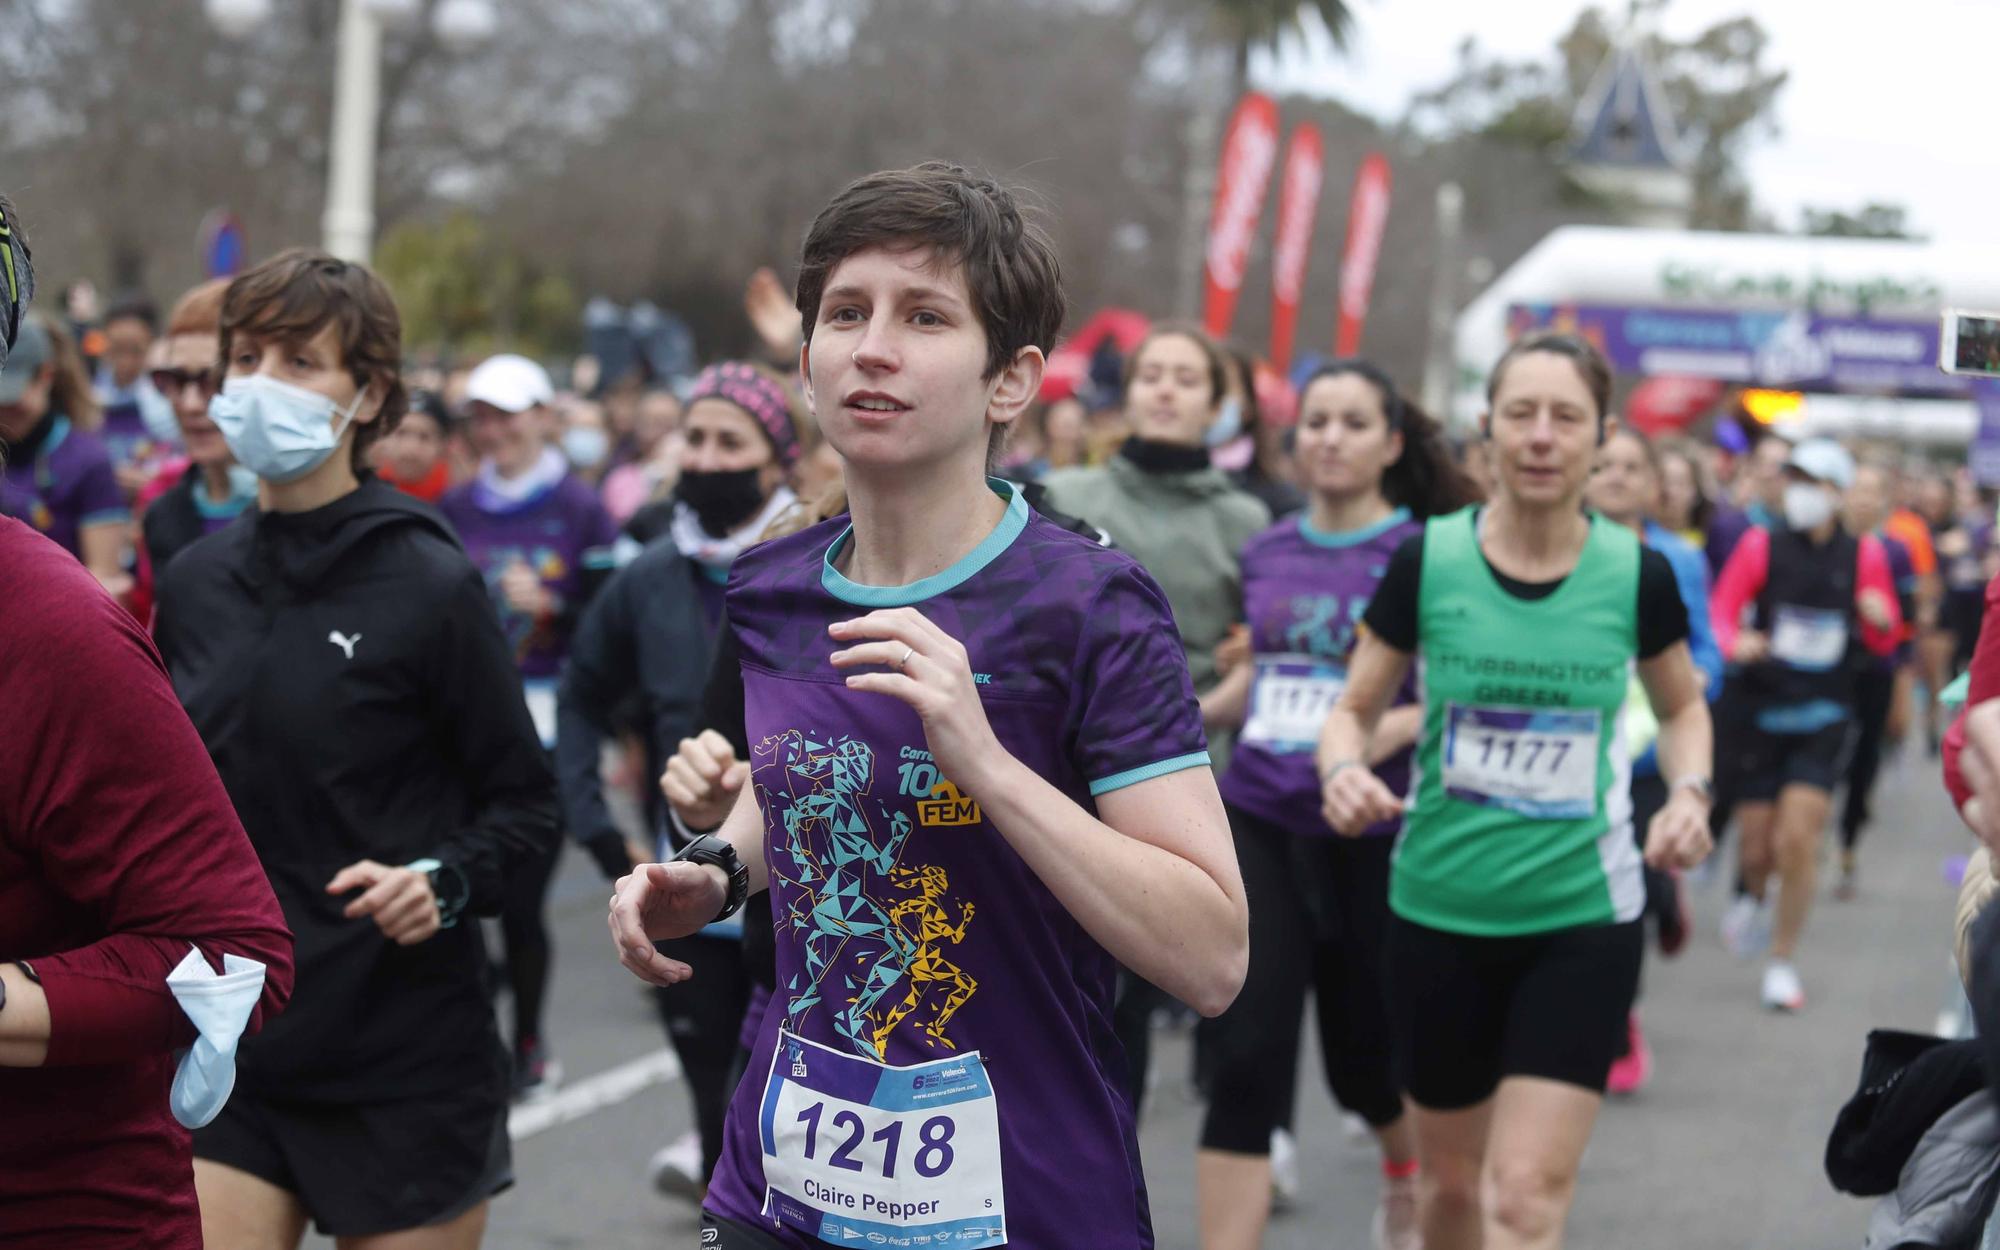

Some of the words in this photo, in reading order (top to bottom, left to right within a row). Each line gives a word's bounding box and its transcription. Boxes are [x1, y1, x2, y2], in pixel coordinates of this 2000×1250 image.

[1475, 682, 1572, 705] GREEN
[1479, 736, 1572, 774] 1177
[924, 800, 976, 823] FEM
[793, 1065, 806, 1076] FEM
[912, 1075, 925, 1090] 6
[797, 1101, 956, 1179] 1218
[804, 1179, 856, 1208] Claire
[862, 1193, 940, 1220] Pepper
